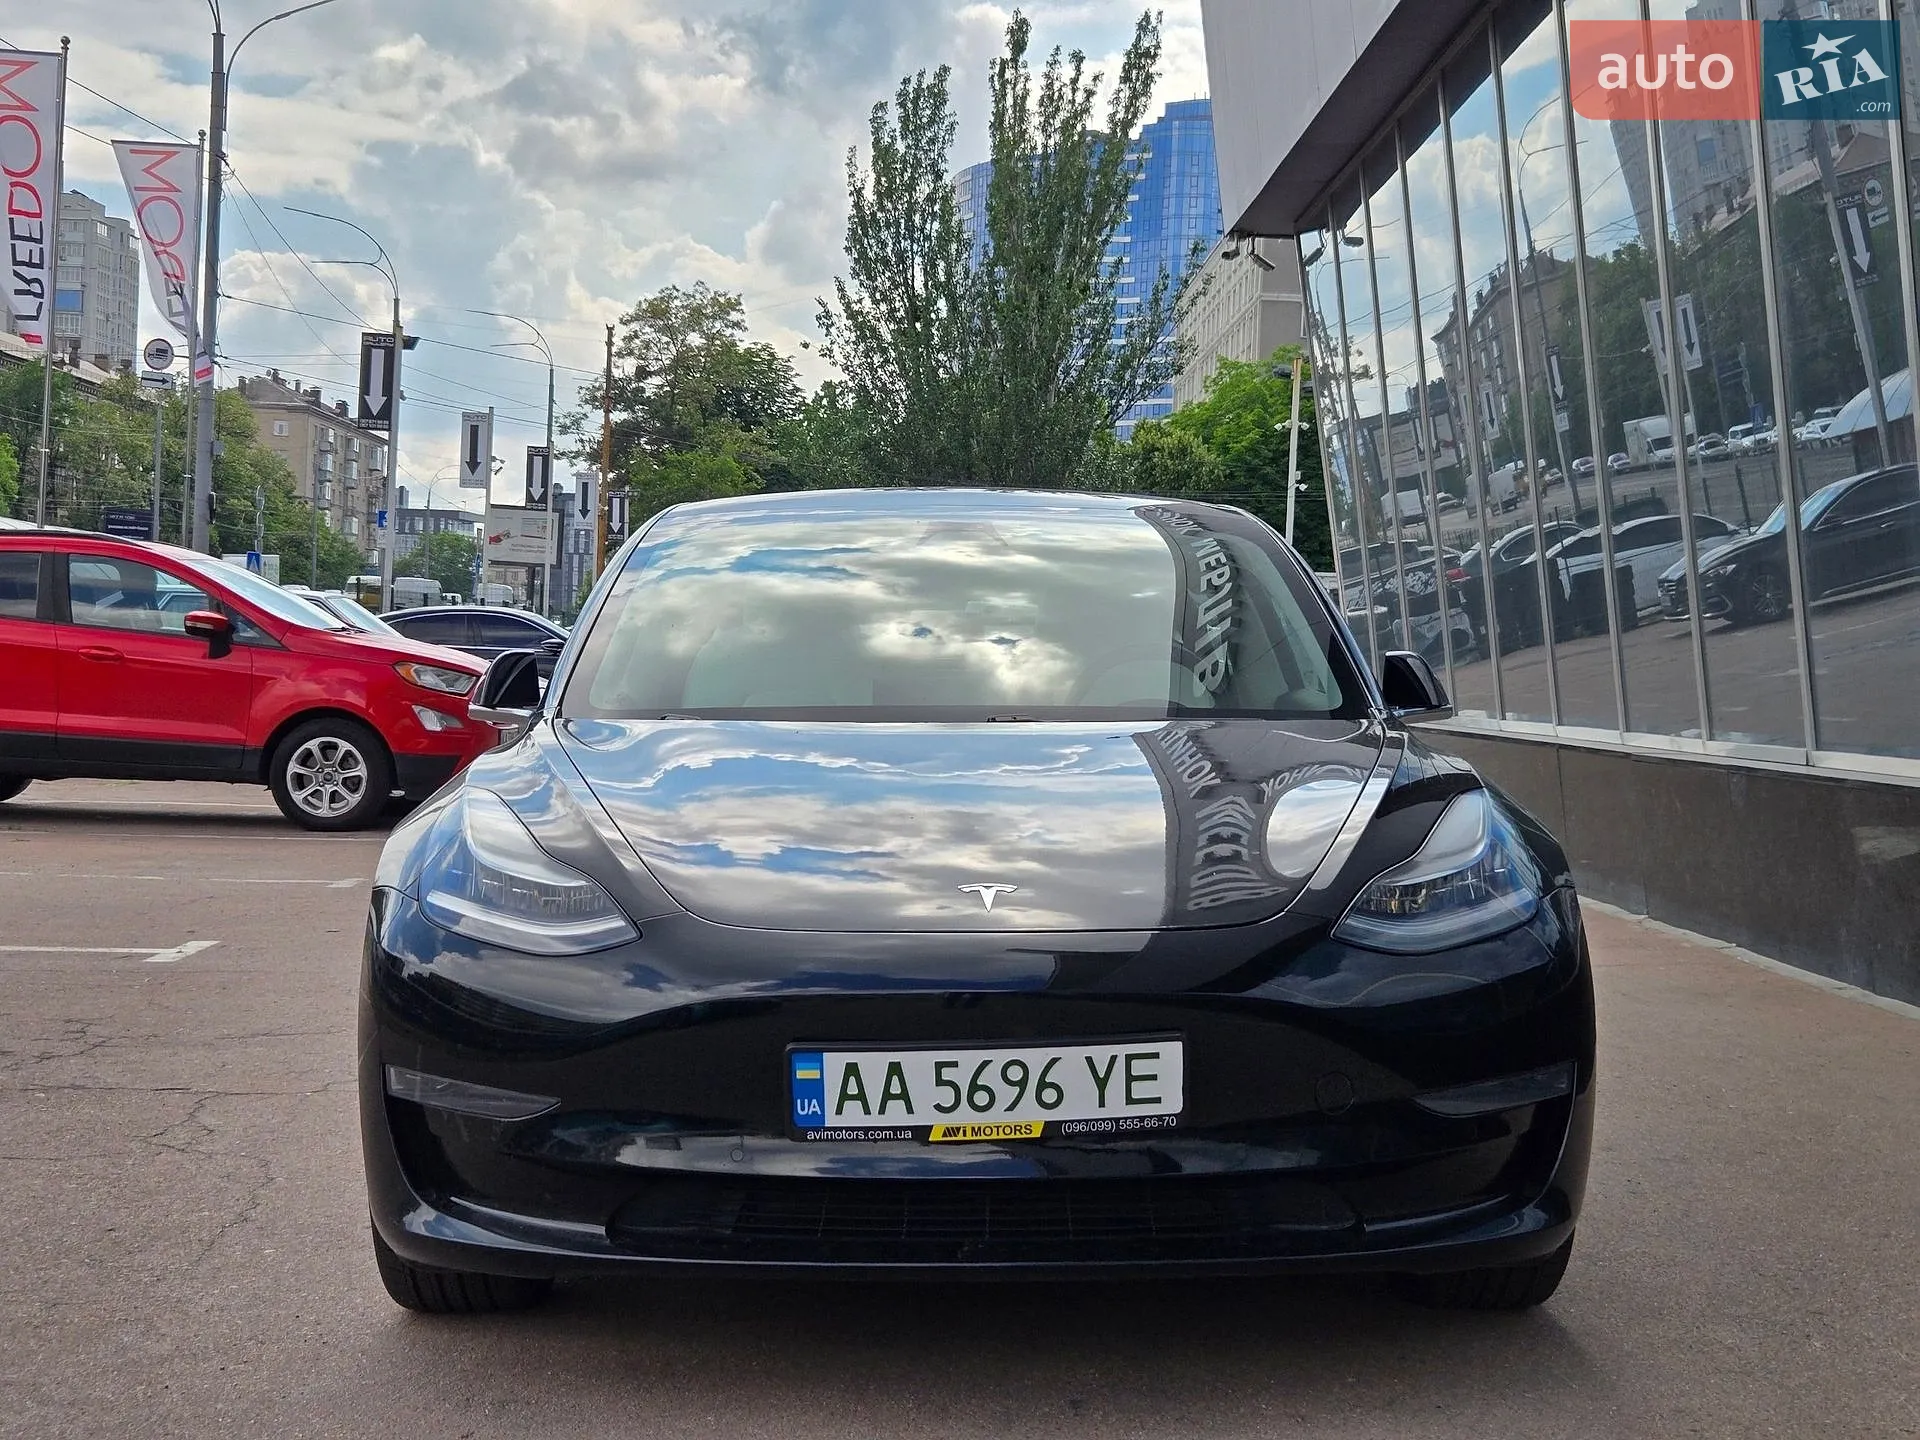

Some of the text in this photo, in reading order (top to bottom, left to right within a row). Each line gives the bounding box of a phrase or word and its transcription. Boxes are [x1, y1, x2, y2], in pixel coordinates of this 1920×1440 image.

[834, 1051, 1162, 1117] AA 5696 YE
[797, 1098, 821, 1116] UA
[970, 1123, 1034, 1138] MOTORS
[1060, 1115, 1177, 1136] (096/099) 555-66-70
[806, 1128, 912, 1142] avimotors.com.ua
